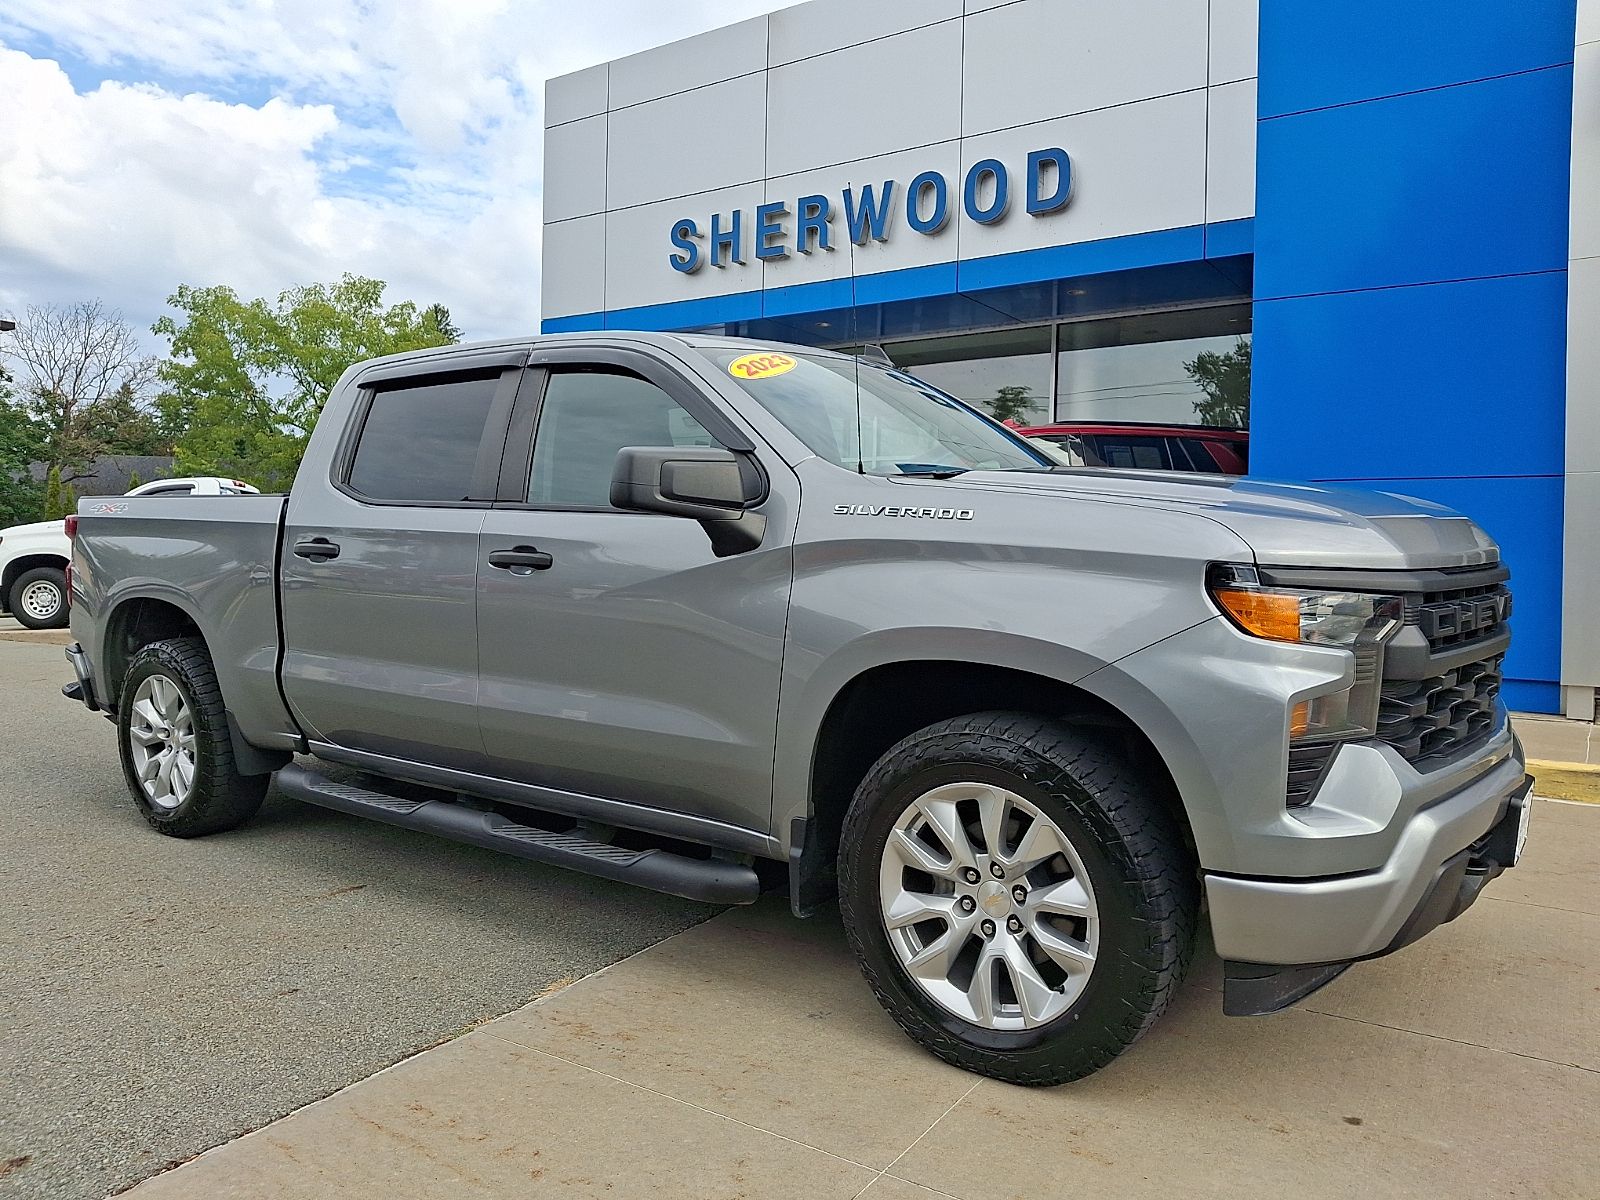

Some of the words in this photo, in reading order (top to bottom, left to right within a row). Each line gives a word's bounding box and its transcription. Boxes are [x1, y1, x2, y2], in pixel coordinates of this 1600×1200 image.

[669, 146, 1075, 275] SHERWOOD
[737, 354, 793, 377] 2023
[833, 503, 975, 521] SILVERADO
